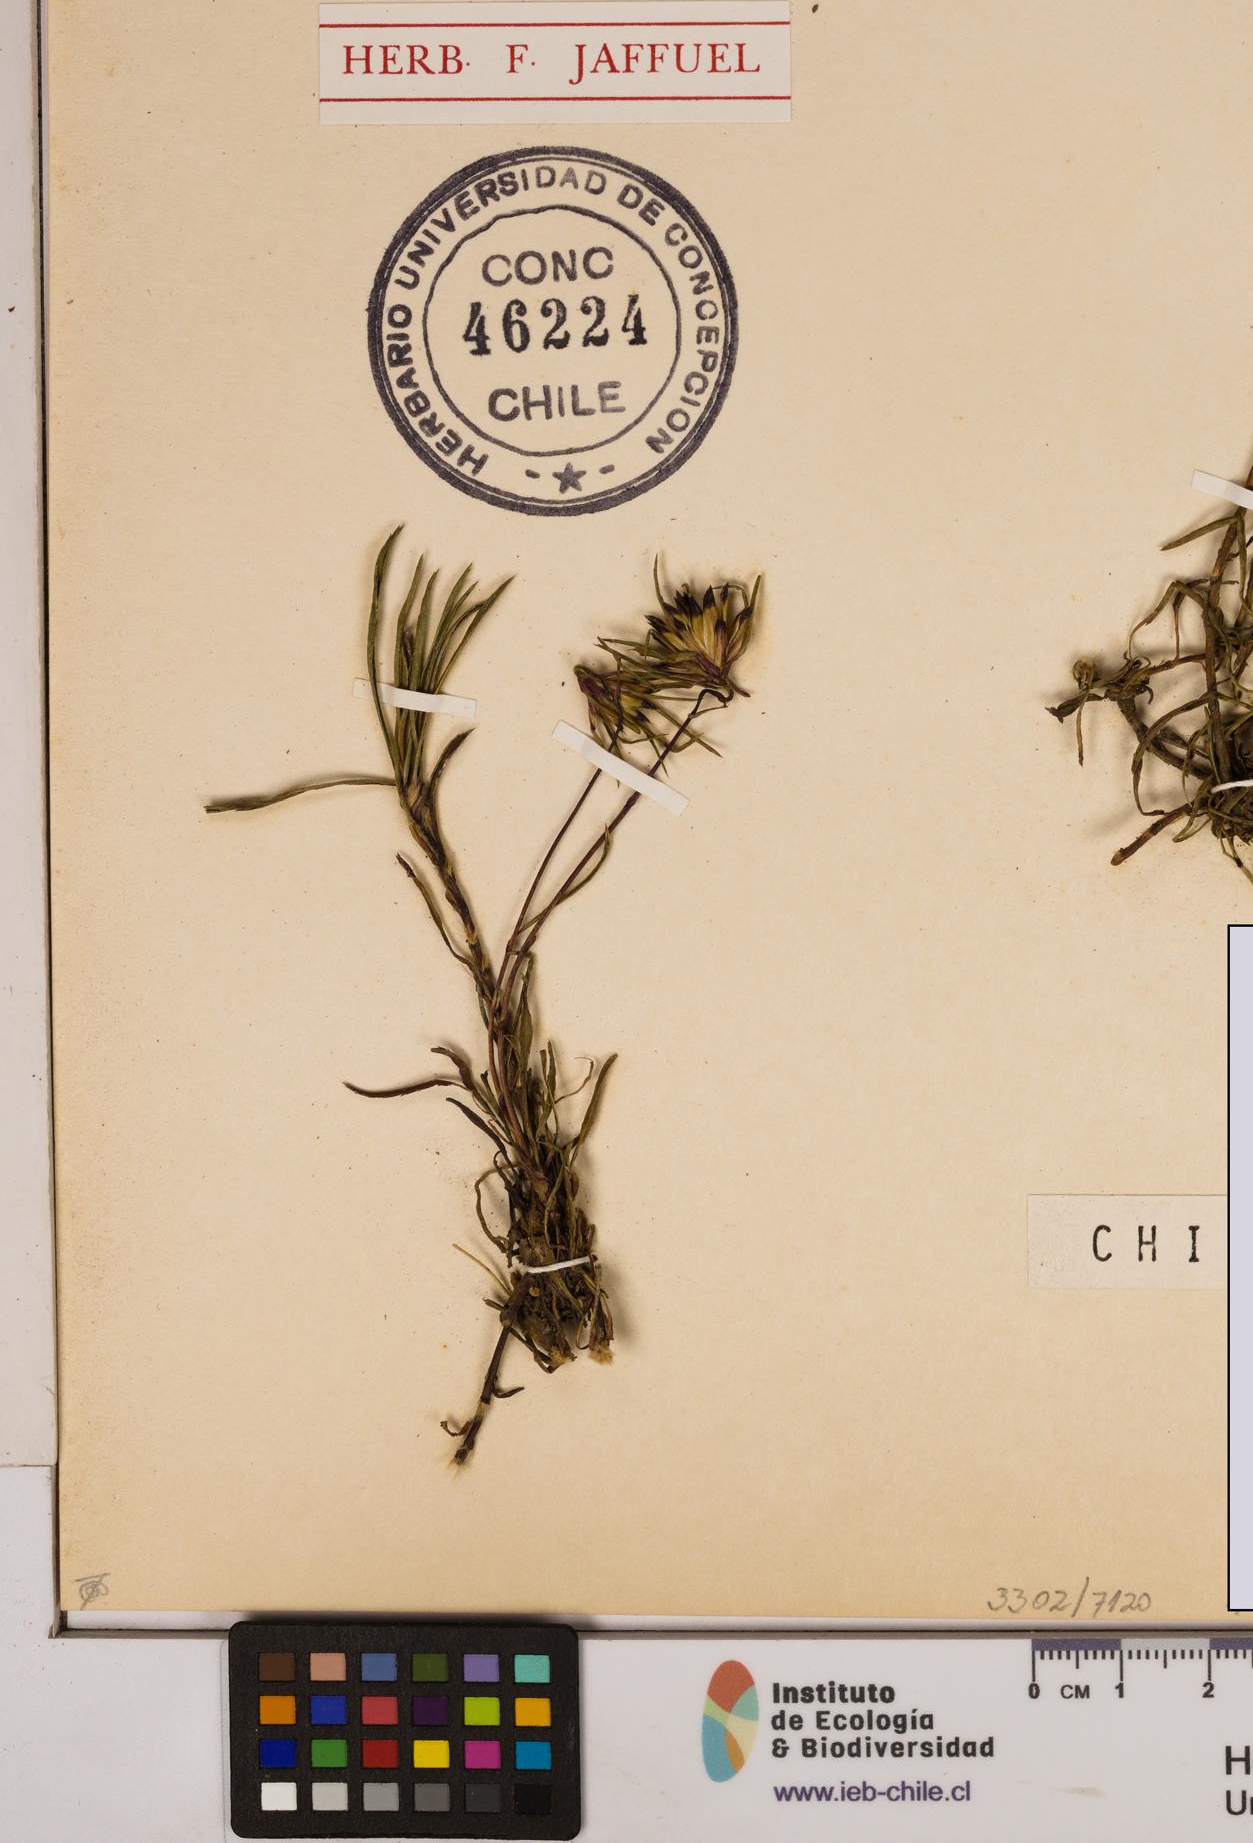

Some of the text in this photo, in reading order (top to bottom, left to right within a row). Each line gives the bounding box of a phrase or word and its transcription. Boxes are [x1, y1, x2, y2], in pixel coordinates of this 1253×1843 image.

[505, 43, 536, 74] F.
[568, 42, 762, 86] JAFFUEL
[481, 245, 614, 287] CONC
[386, 165, 721, 476] HERBARIO UNIVERSIDAD DE CONCEPCION
[462, 293, 648, 357] 46224
[487, 379, 626, 422] CHILE
[772, 1680, 896, 1705] Instituto
[1027, 1683, 1041, 1700] 0
[1059, 1684, 1091, 1700] CM
[1114, 1682, 1125, 1699] 1
[1201, 1682, 1215, 1699] 2
[770, 1708, 934, 1735] de Ecología
[771, 1735, 995, 1759] & Biodiversidad
[772, 1780, 971, 1802] www.ieb-chile.cl
